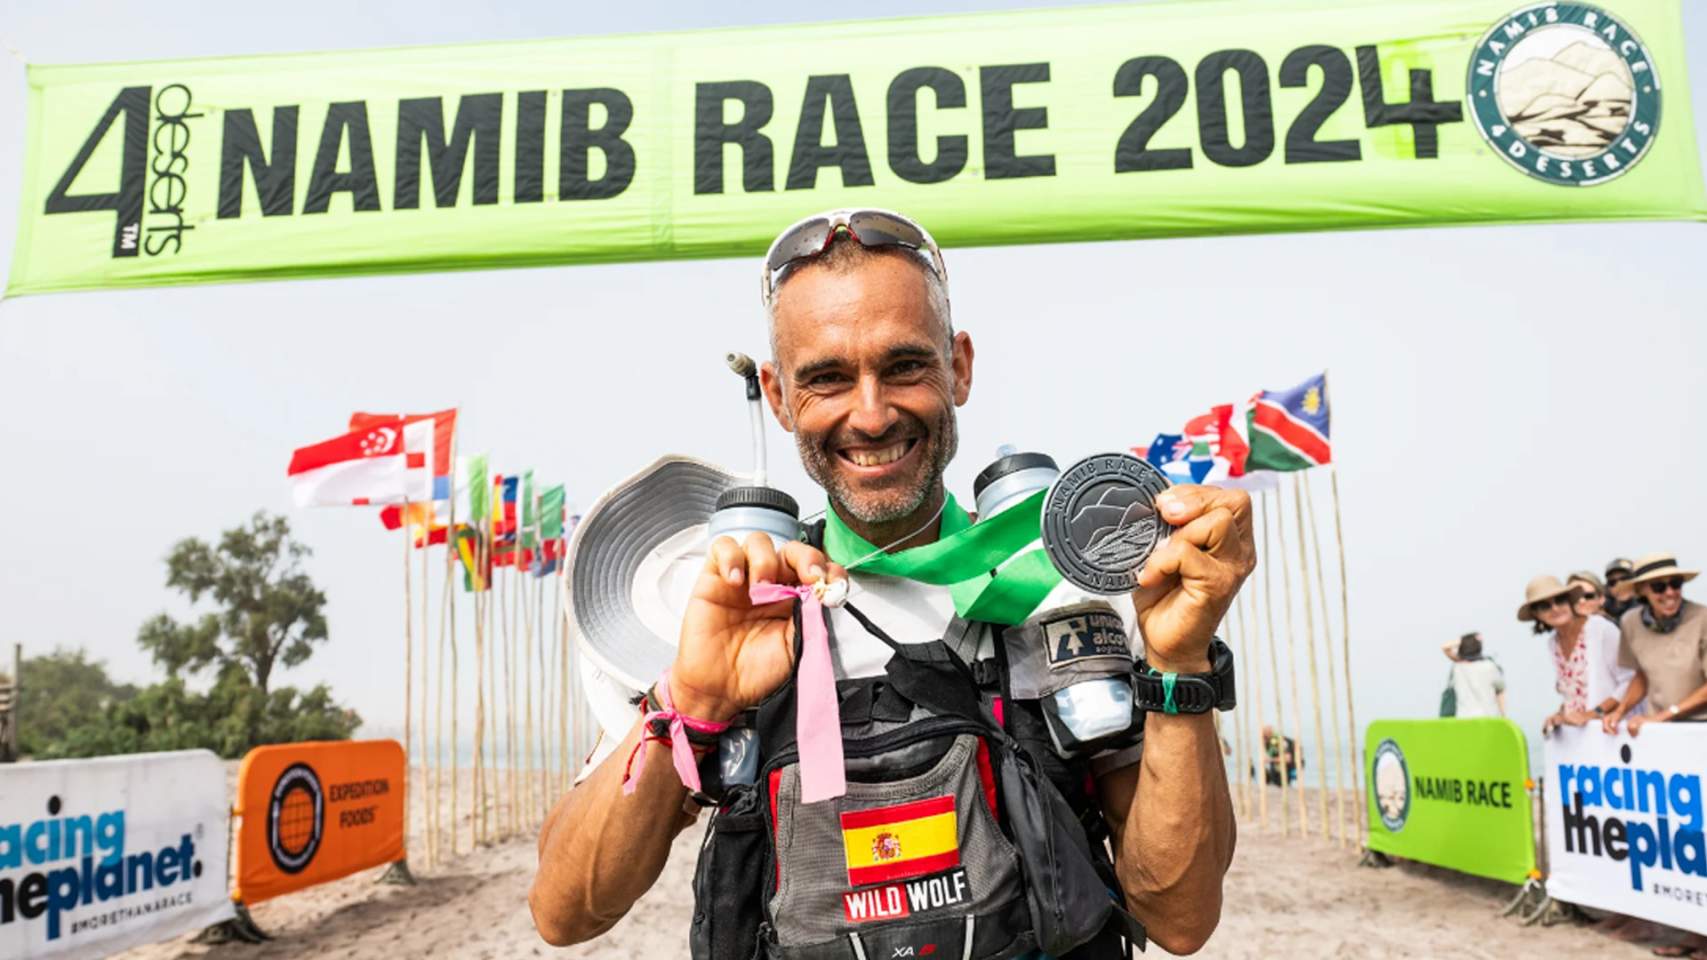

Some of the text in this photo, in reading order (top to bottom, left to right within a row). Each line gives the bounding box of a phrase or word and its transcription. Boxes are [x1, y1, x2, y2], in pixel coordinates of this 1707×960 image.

[1476, 7, 1647, 76] NAMIB RACE
[216, 44, 1464, 220] NAMIB RACE 2024
[1509, 121, 1650, 178] DESERTS
[44, 85, 153, 258] 4
[144, 83, 204, 257] deserts
[1052, 458, 1148, 512] NAMIB RACE
[329, 778, 389, 803] EXPEDITION
[1414, 776, 1513, 809] NAMIB RACE
[1558, 744, 1705, 832] racing
[845, 871, 967, 920] WILD WOLF
[1653, 883, 1707, 907] #MORE
